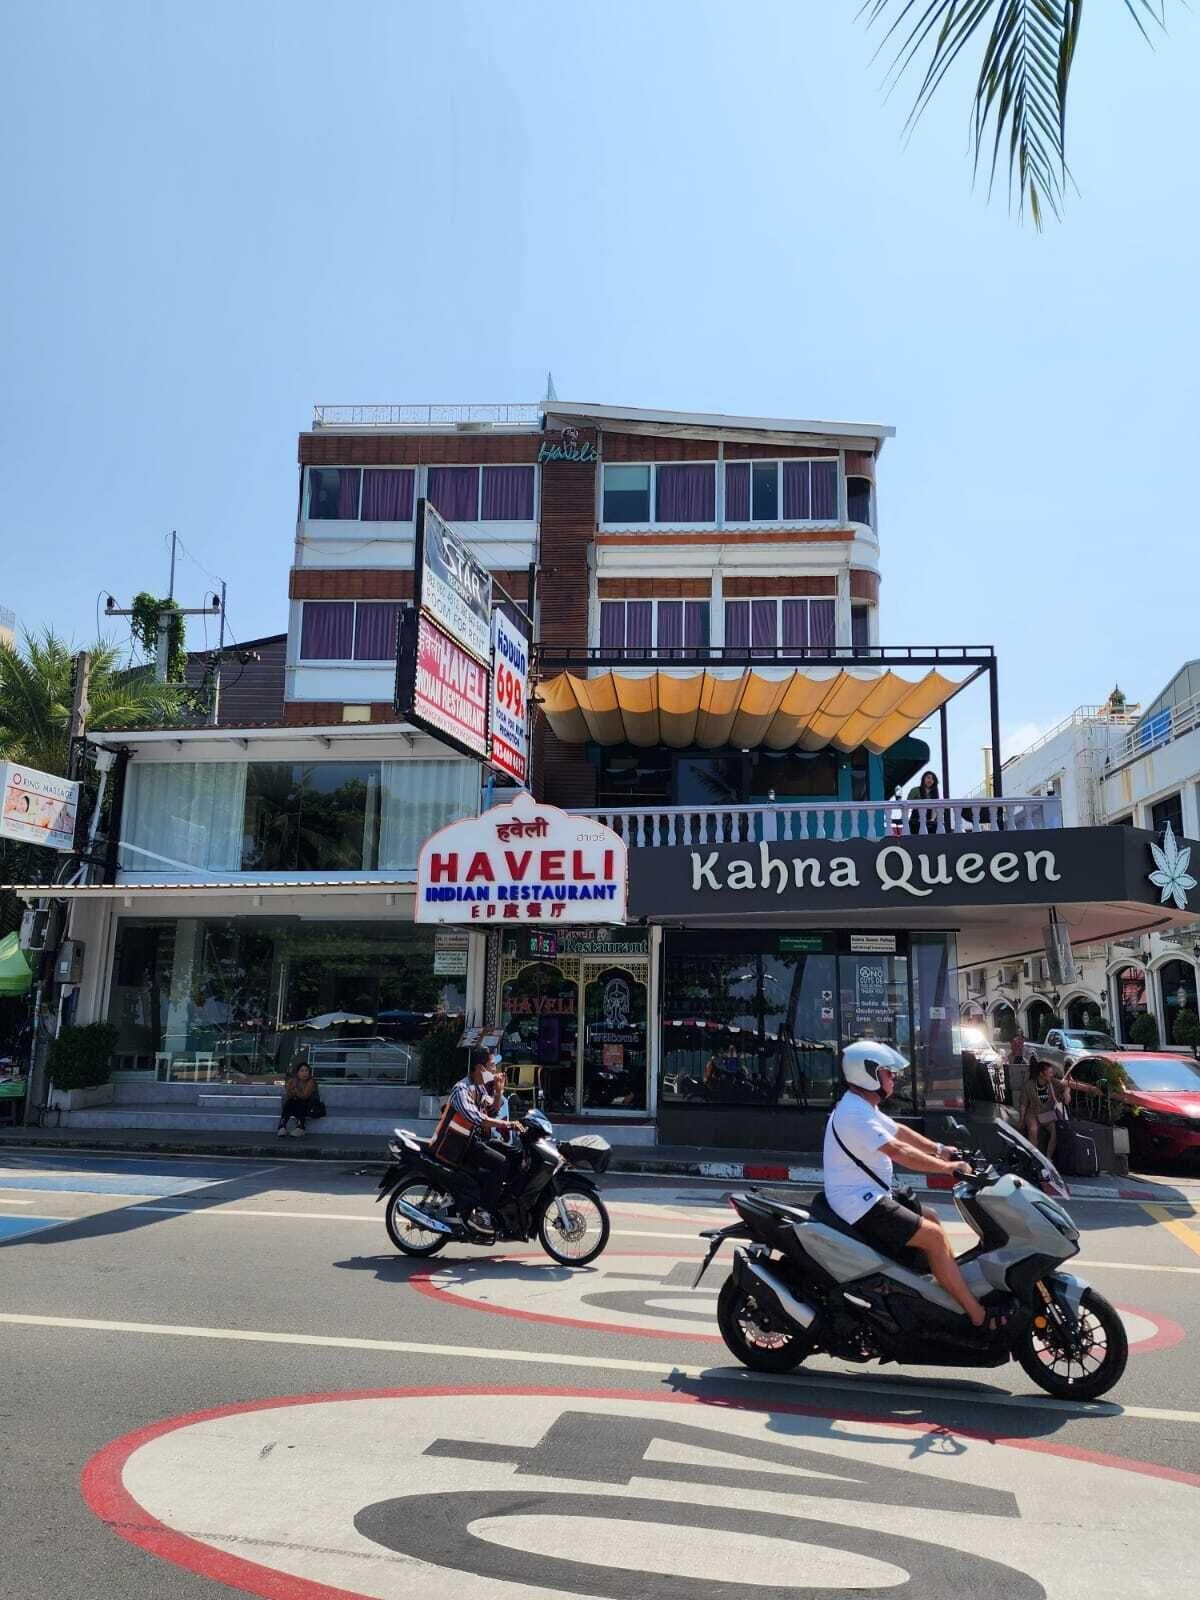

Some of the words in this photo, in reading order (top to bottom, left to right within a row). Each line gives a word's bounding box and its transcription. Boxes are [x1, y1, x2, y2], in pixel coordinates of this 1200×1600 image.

[440, 537, 482, 603] STAR
[438, 639, 486, 709] HAVELI
[415, 663, 441, 707] INDIAN
[441, 682, 485, 737] RESTAURANT
[496, 817, 549, 842] हवेली
[430, 850, 614, 883] HAVELI
[691, 841, 860, 894] Kahna
[875, 846, 1062, 897] Queen
[425, 886, 490, 902] INDIAN
[497, 885, 617, 901] RESTAURANT
[471, 903, 566, 918] 印度餐厅
[562, 939, 648, 953] Restaurant
[504, 997, 577, 1015] HAVELI
[353, 1410, 1048, 1600] 40
